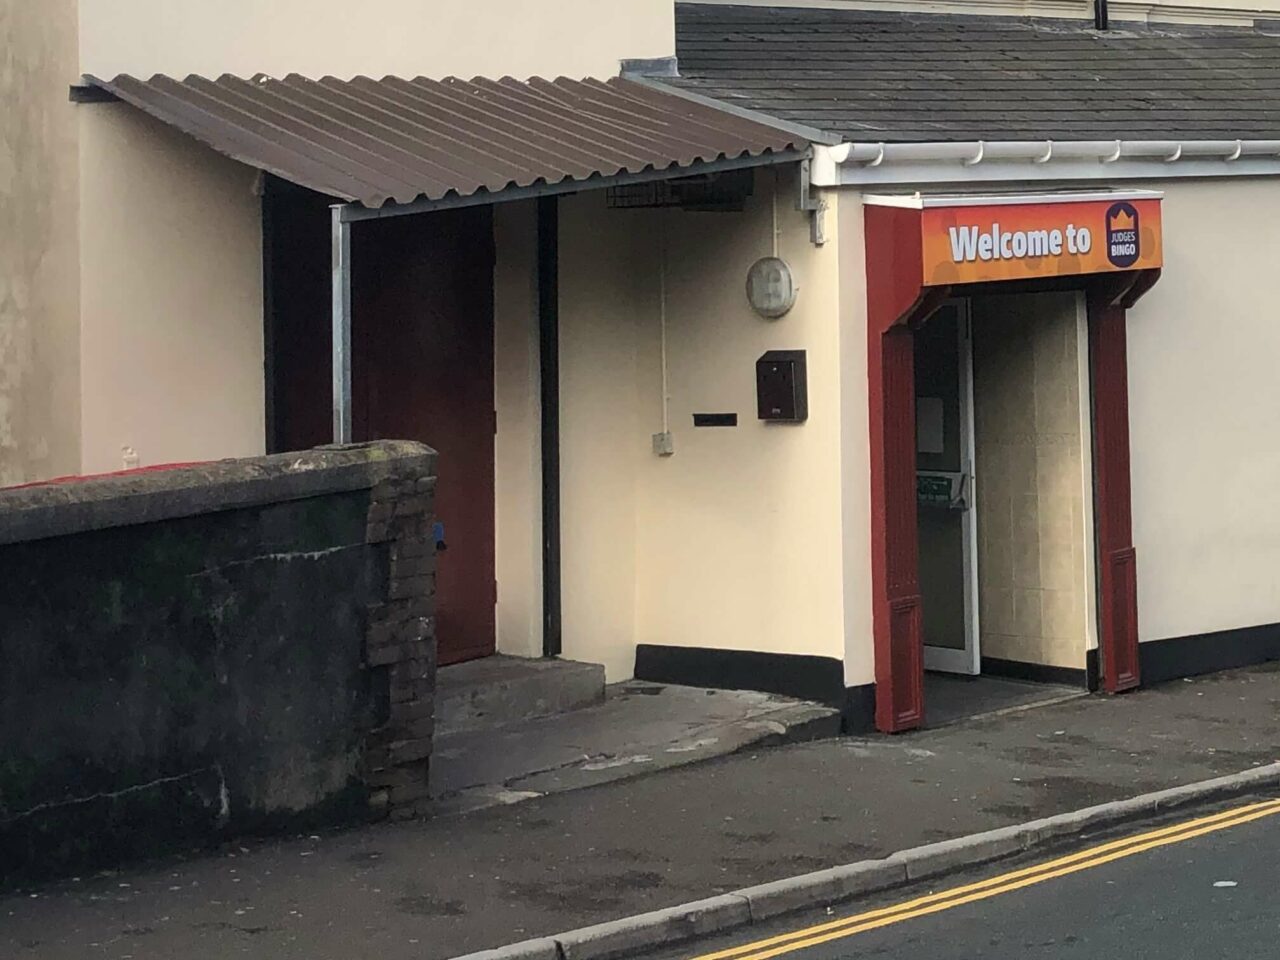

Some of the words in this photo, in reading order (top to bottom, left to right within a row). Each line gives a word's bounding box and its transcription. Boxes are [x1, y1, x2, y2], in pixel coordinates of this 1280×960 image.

[949, 223, 1062, 262] Welcome
[1066, 223, 1091, 255] to
[1111, 231, 1136, 243] JUDGES
[1111, 243, 1136, 256] BINGO
